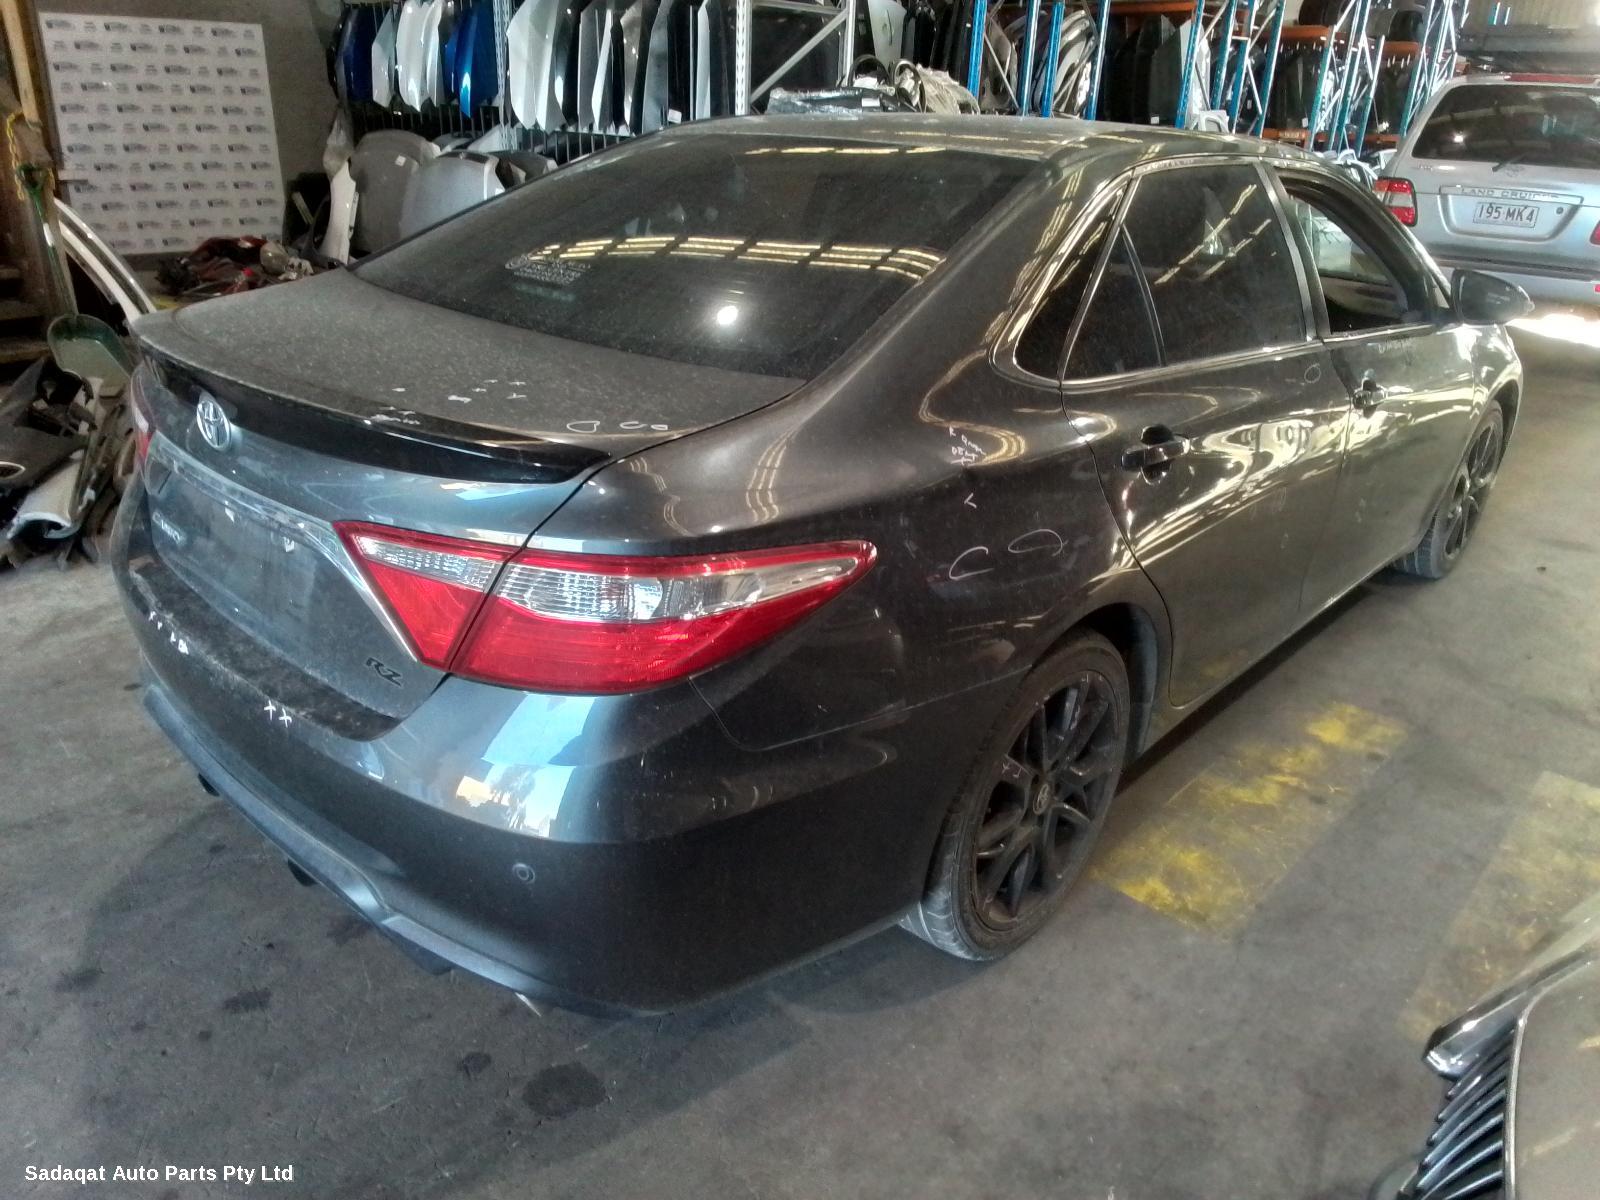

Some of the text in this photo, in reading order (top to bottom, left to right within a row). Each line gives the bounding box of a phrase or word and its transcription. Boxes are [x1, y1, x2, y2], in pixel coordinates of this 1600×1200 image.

[1461, 187, 1495, 198] LAND
[1478, 204, 1535, 222] 195 MK4
